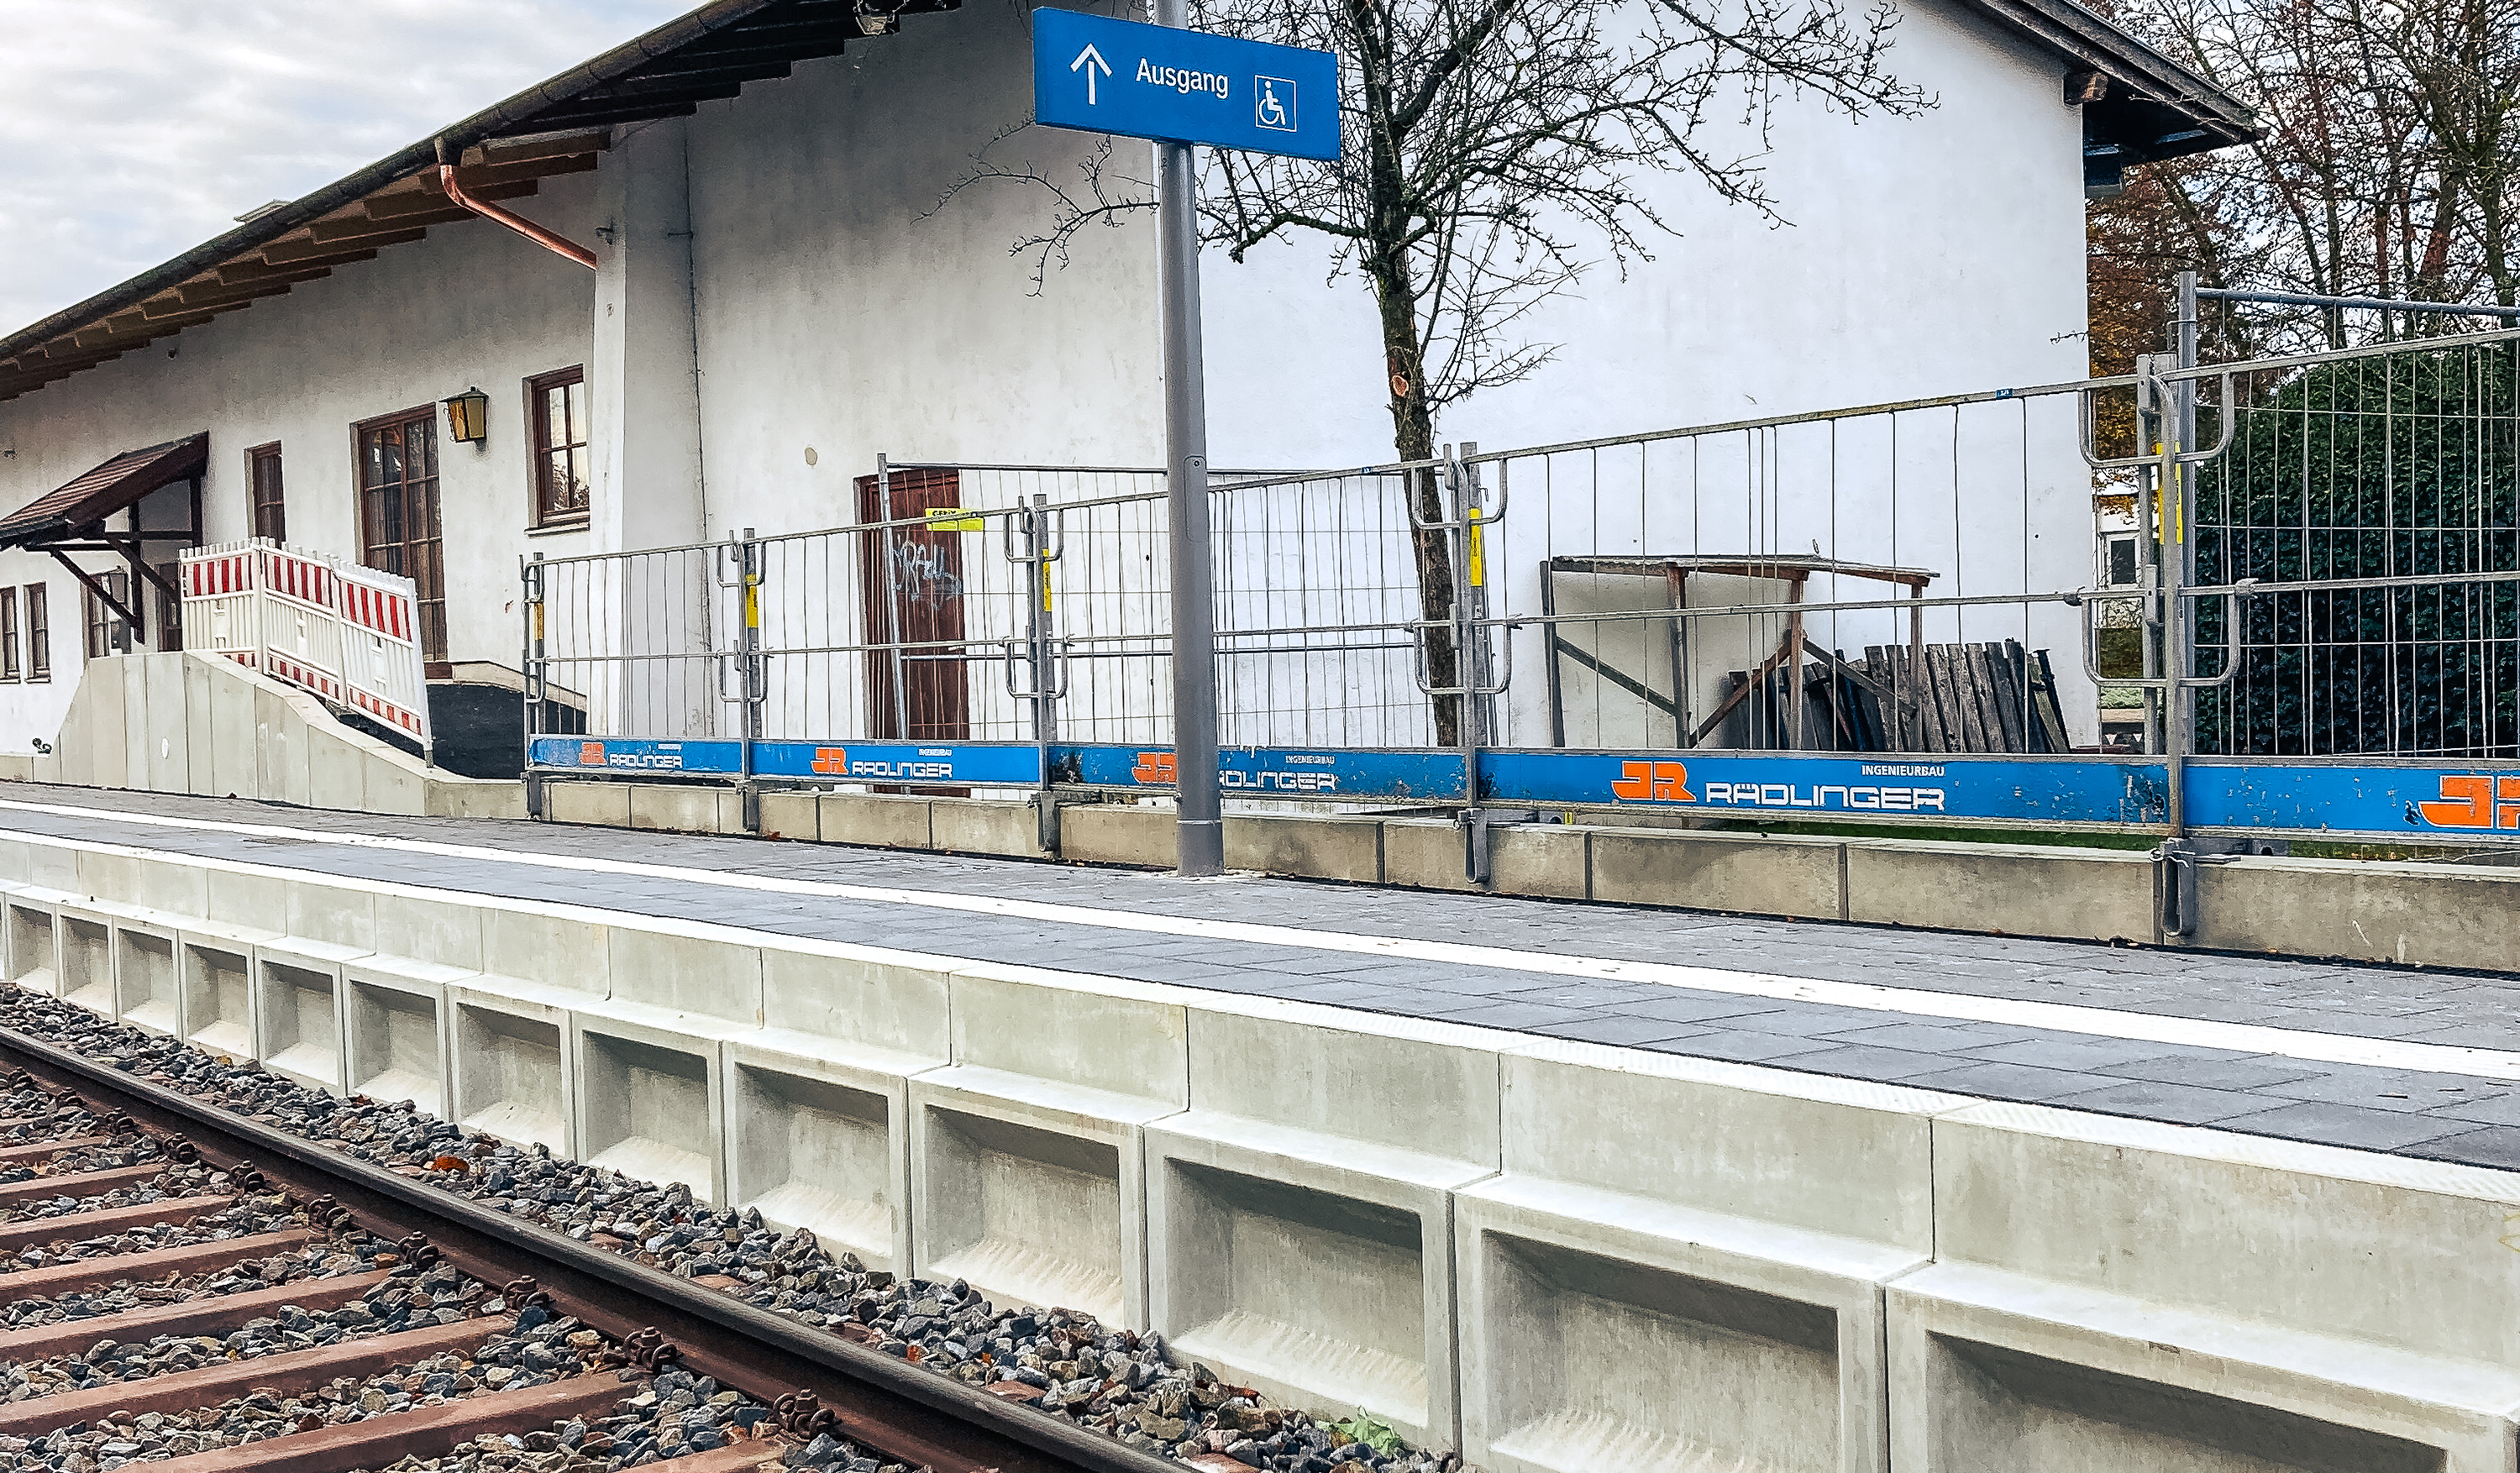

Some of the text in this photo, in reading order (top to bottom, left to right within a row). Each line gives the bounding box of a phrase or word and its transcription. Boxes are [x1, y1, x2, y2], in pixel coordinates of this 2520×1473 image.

[1136, 57, 1229, 99] Ausgang
[1219, 770, 1336, 790] DLINGER
[1861, 764, 1945, 776] INGENIEURBAU
[1705, 783, 1945, 811] RÄDLINGER
[2418, 775, 2520, 830] J
